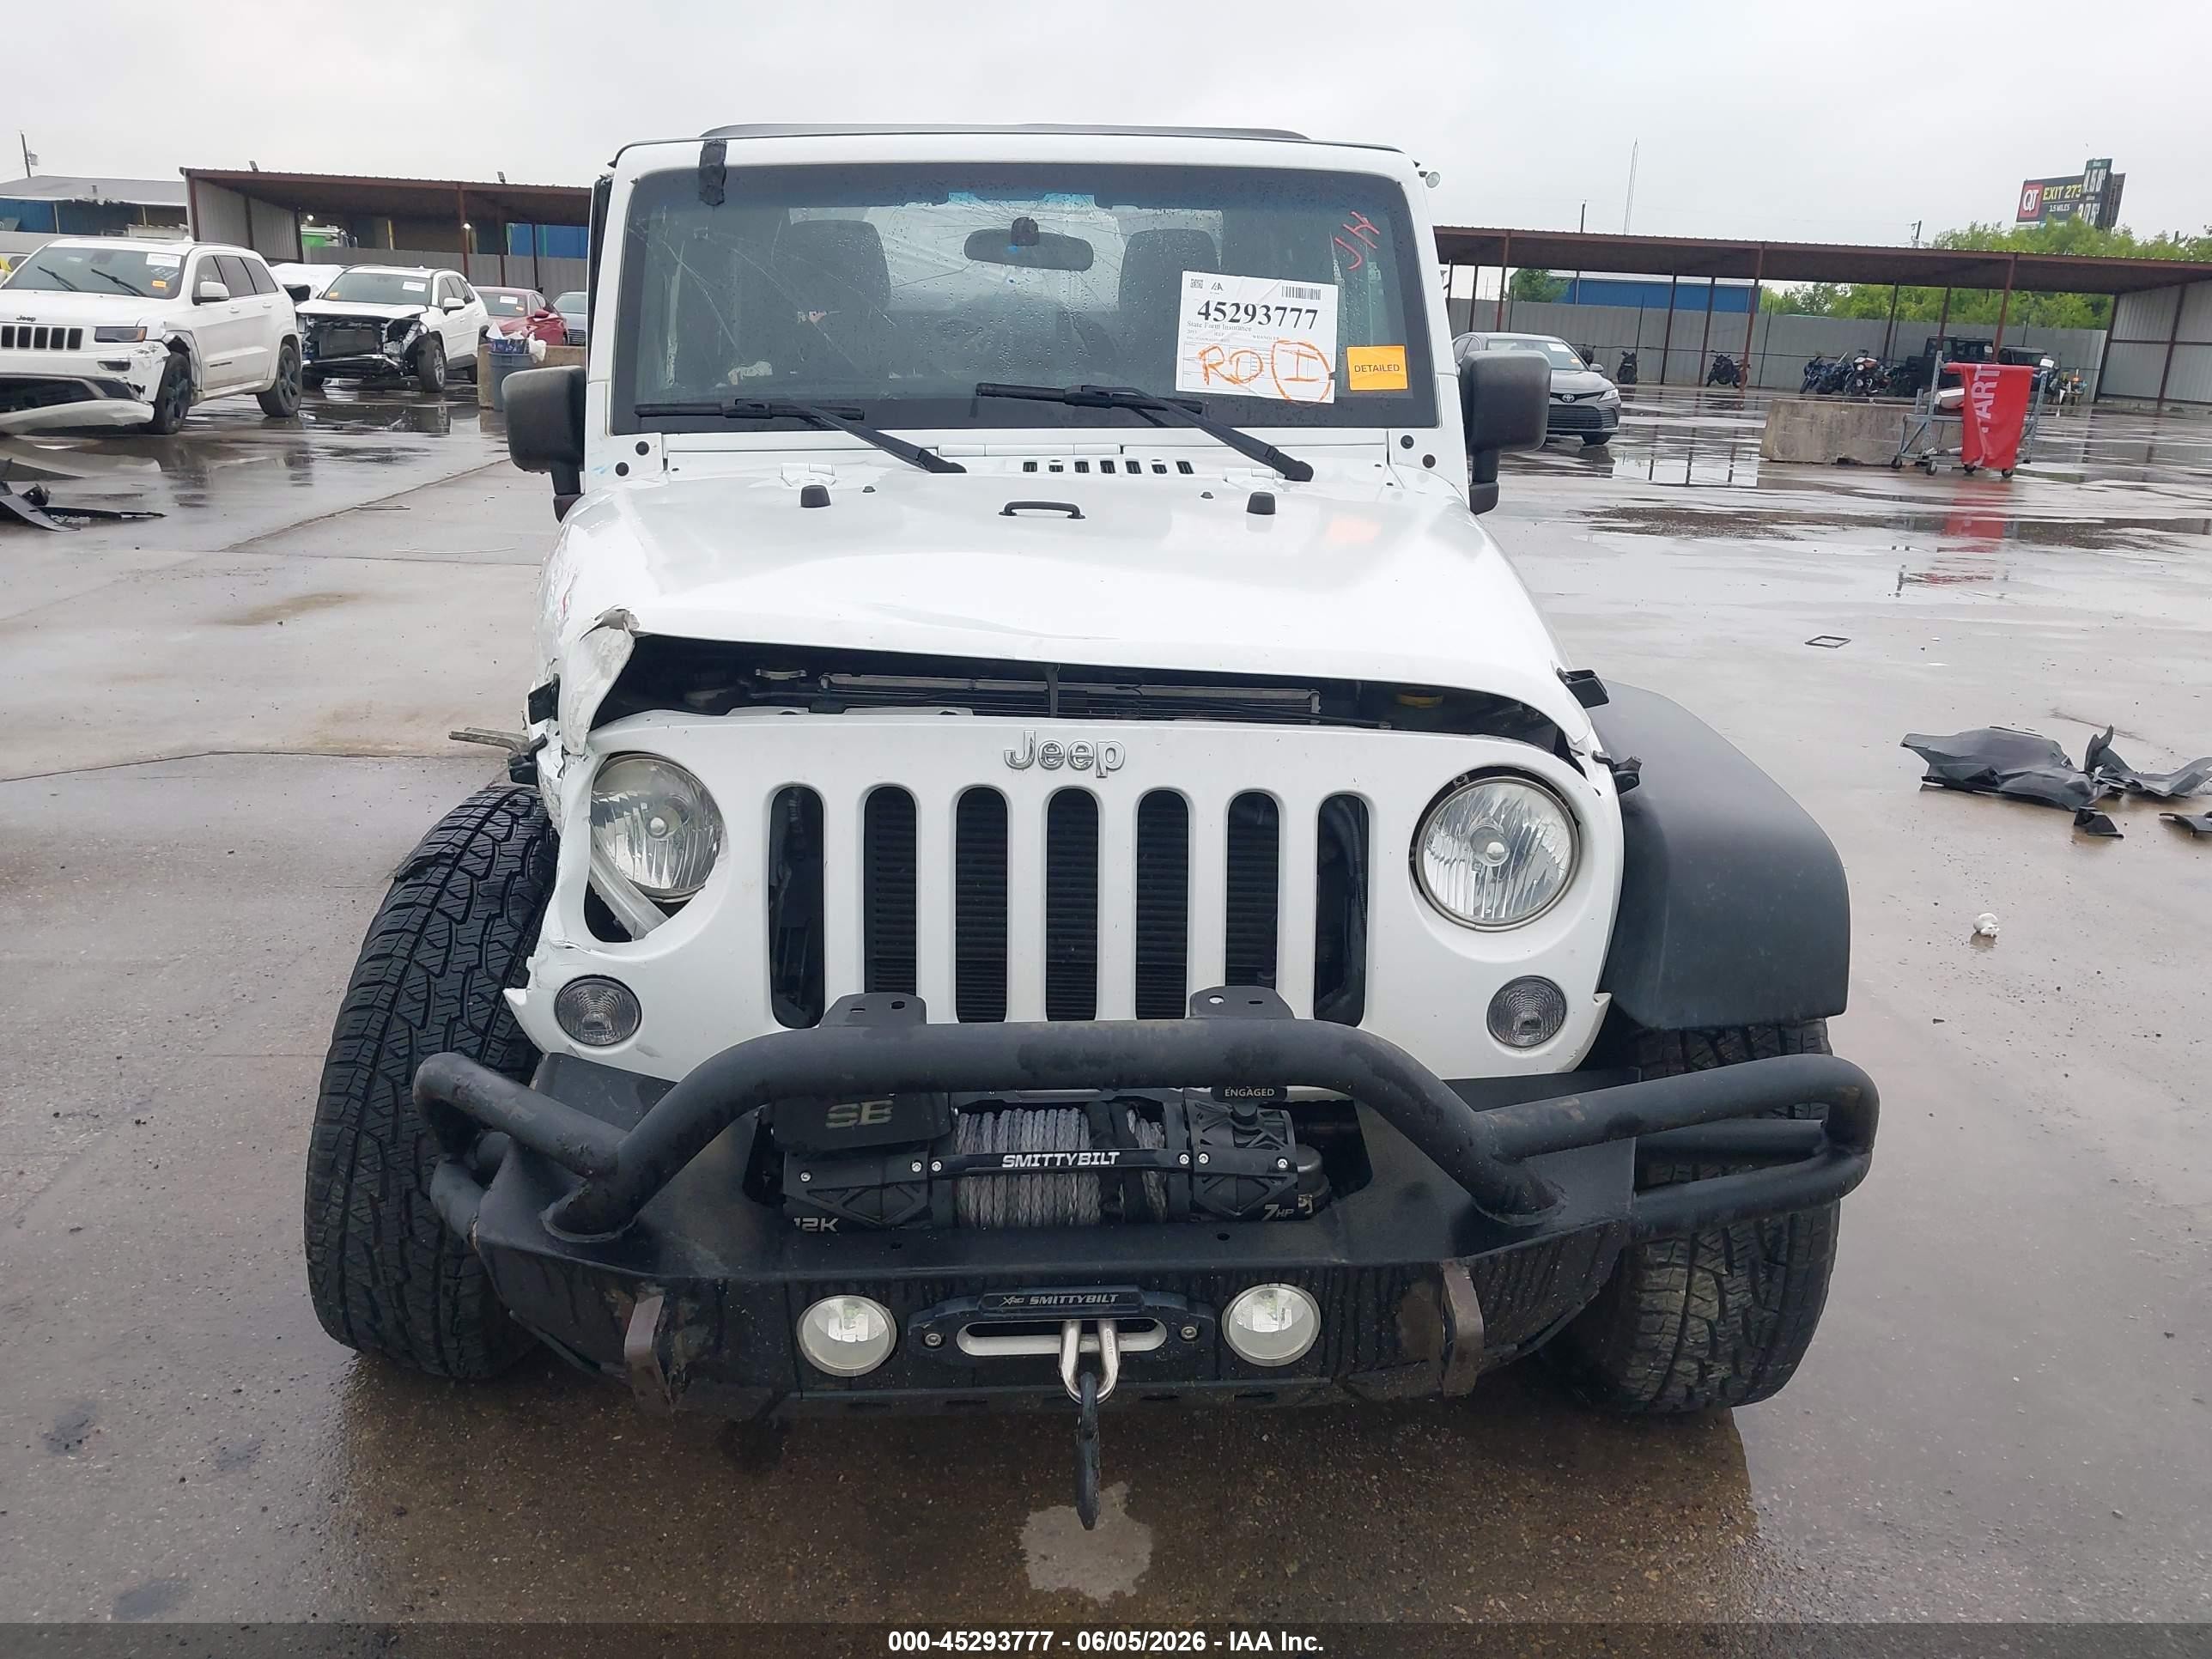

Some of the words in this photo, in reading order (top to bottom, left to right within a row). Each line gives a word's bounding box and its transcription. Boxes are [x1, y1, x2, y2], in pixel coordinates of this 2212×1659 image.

[2043, 185, 2064, 200] EXIT
[2064, 184, 2082, 199] 273
[2023, 190, 2039, 213] QT
[1197, 300, 1319, 330] 45293777
[1354, 363, 1400, 374] DETAILED
[1004, 730, 1126, 778] Jeep
[1224, 1088, 1275, 1097] ENGAGED
[1001, 1152, 1121, 1168] SMITTYBILT
[793, 1217, 839, 1232] 12K
[1030, 1294, 1120, 1305] SMITTYBILT
